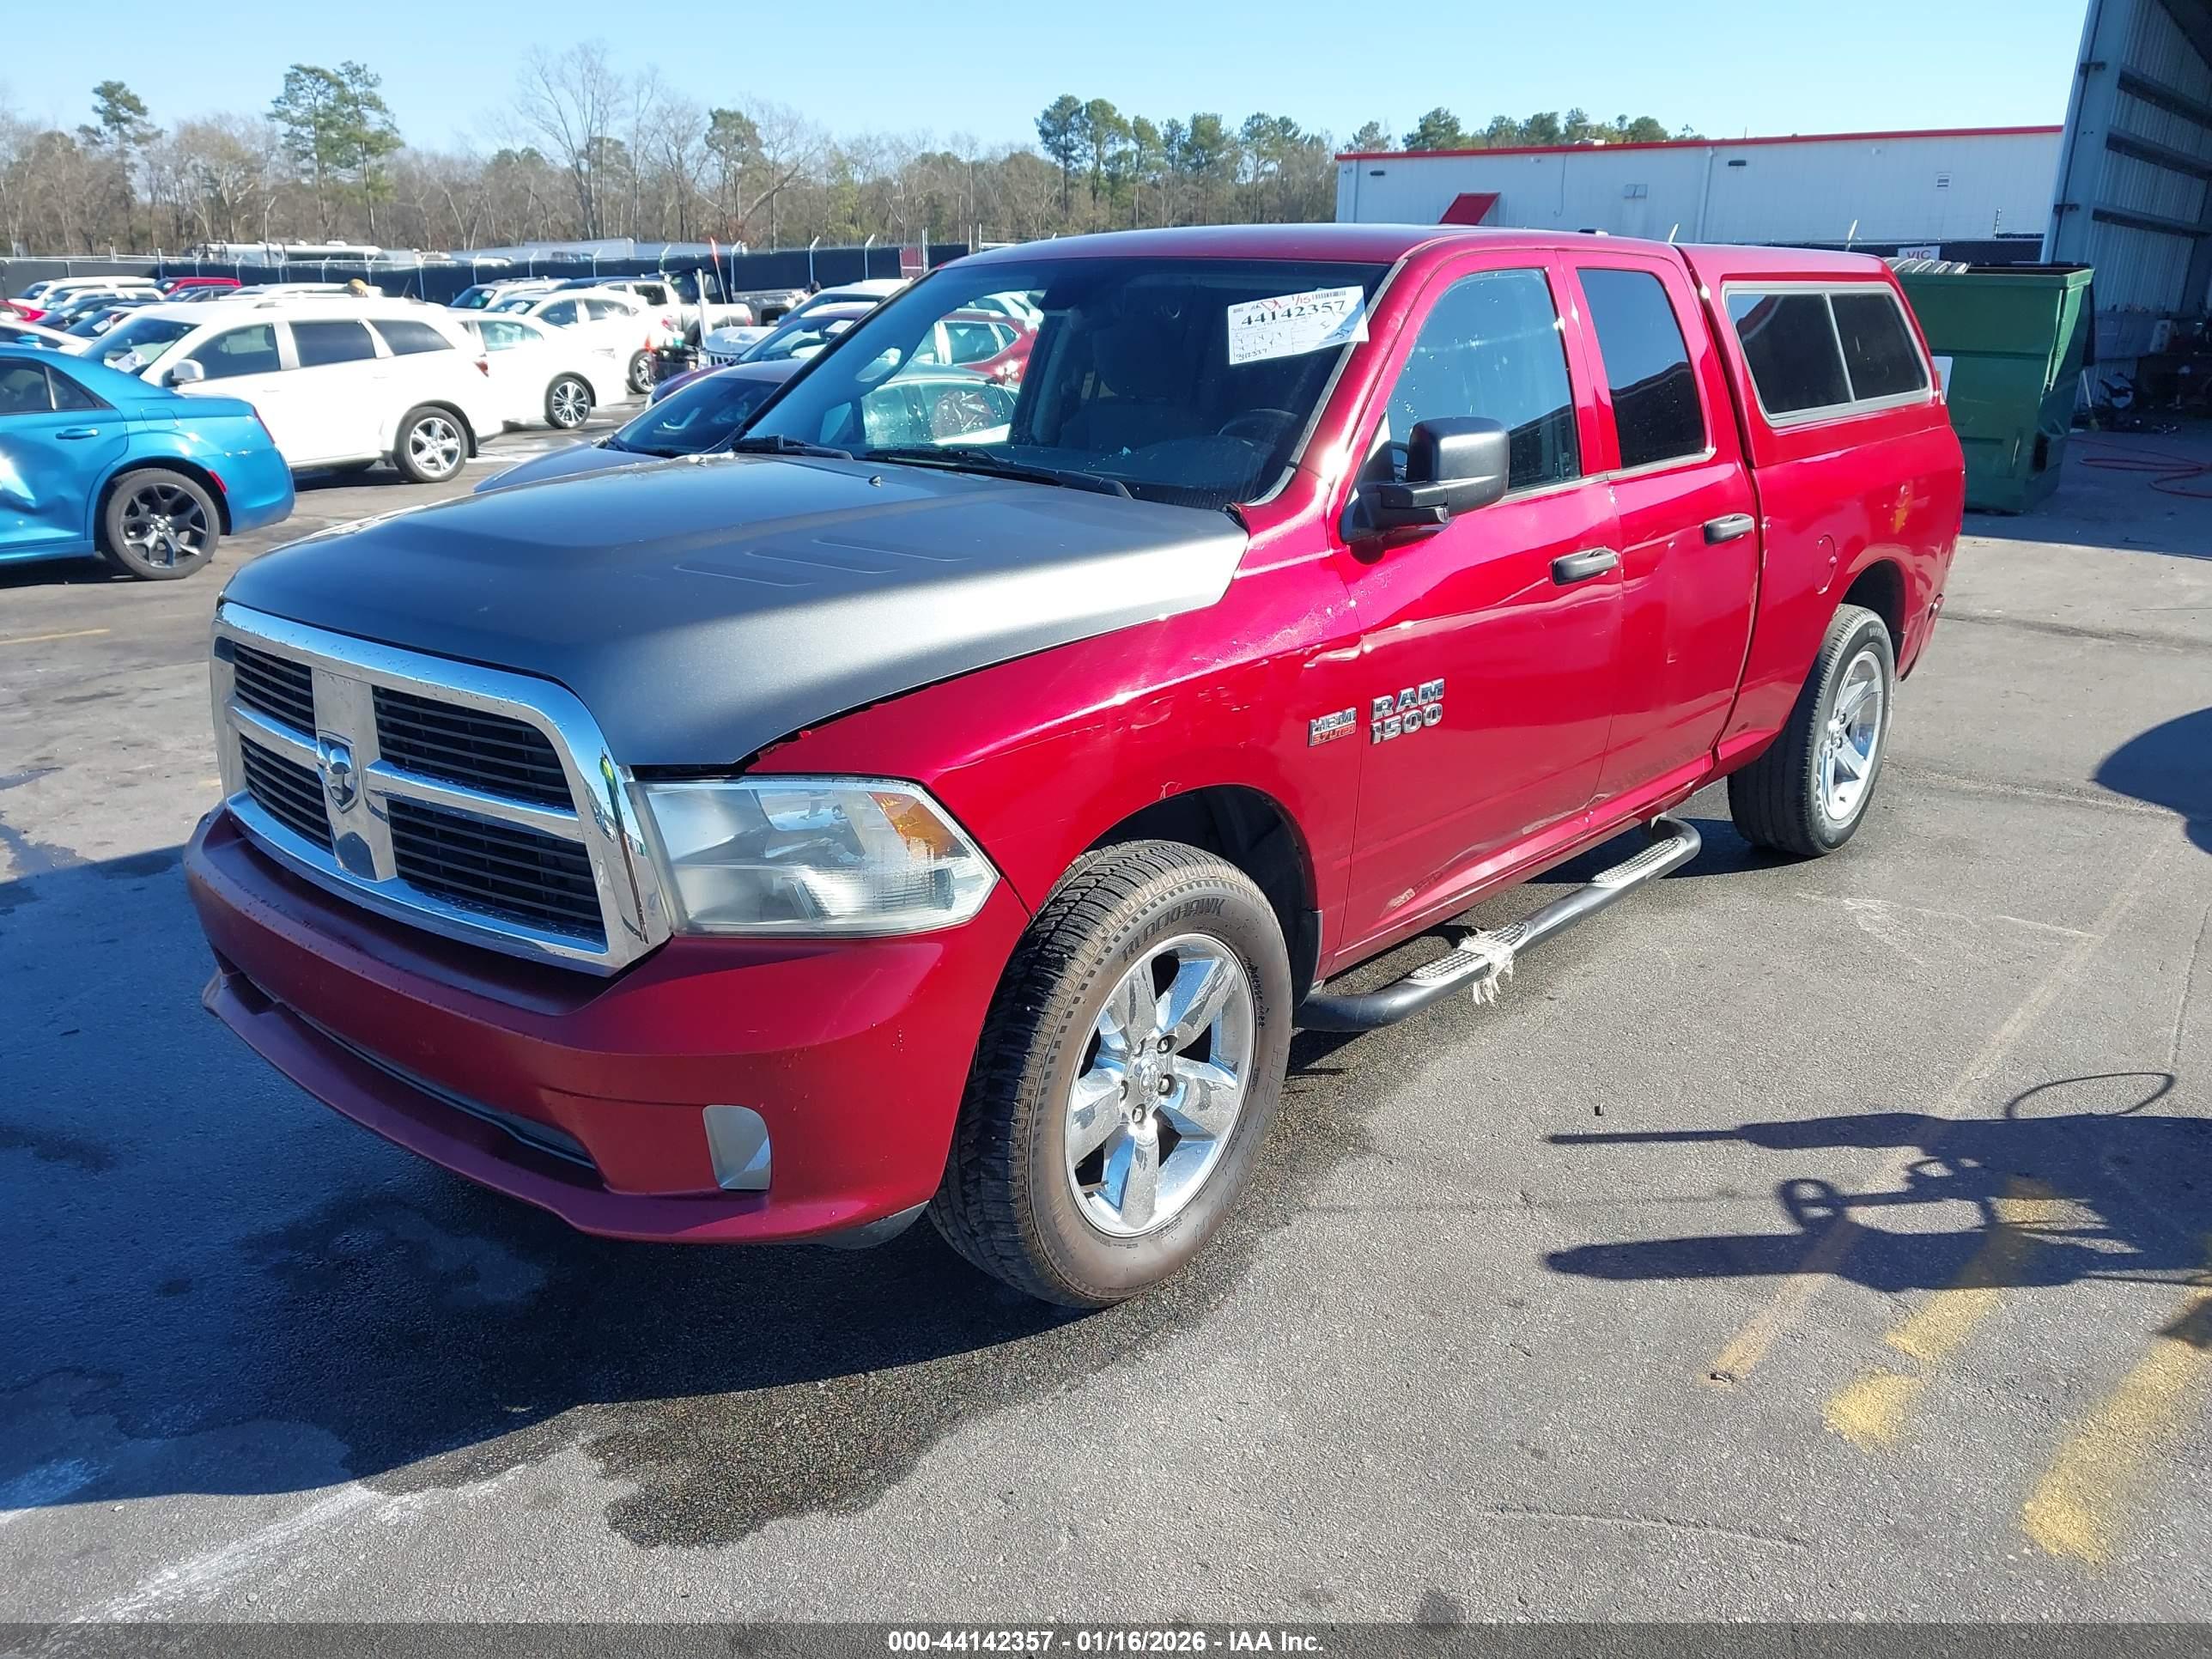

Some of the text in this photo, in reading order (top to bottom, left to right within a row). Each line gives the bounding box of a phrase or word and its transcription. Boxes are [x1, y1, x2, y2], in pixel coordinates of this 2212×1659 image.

[1241, 300, 1346, 325] 44142357
[1371, 678, 1444, 721] RAM
[1310, 708, 1357, 732] HEMI
[1370, 702, 1443, 744] 1500
